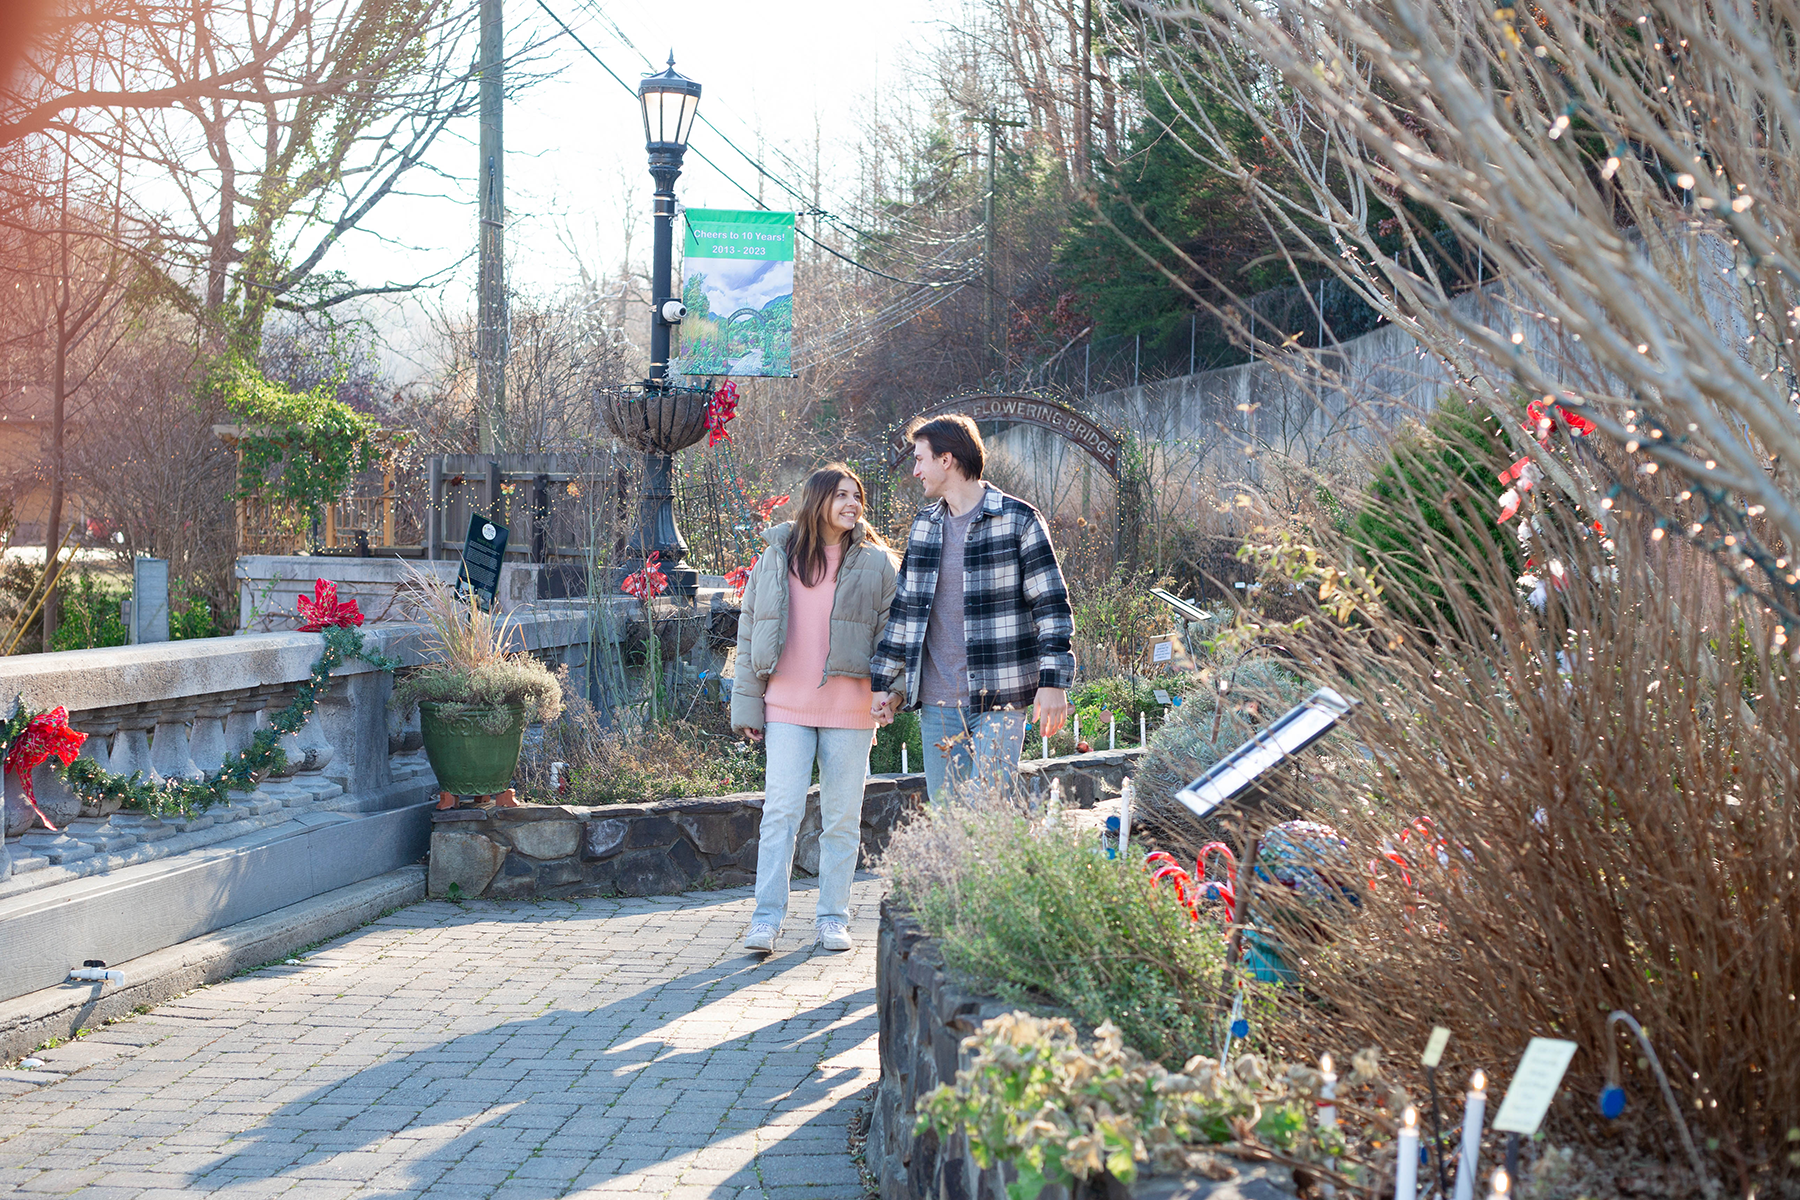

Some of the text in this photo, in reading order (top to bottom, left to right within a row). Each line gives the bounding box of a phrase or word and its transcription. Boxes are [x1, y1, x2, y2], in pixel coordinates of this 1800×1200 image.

[693, 229, 785, 242] Cheers to 10 Years!
[712, 245, 735, 254] 2013
[743, 246, 766, 256] 2023
[973, 400, 1063, 425] FLOWERING
[1065, 417, 1116, 461] BRIDGE
